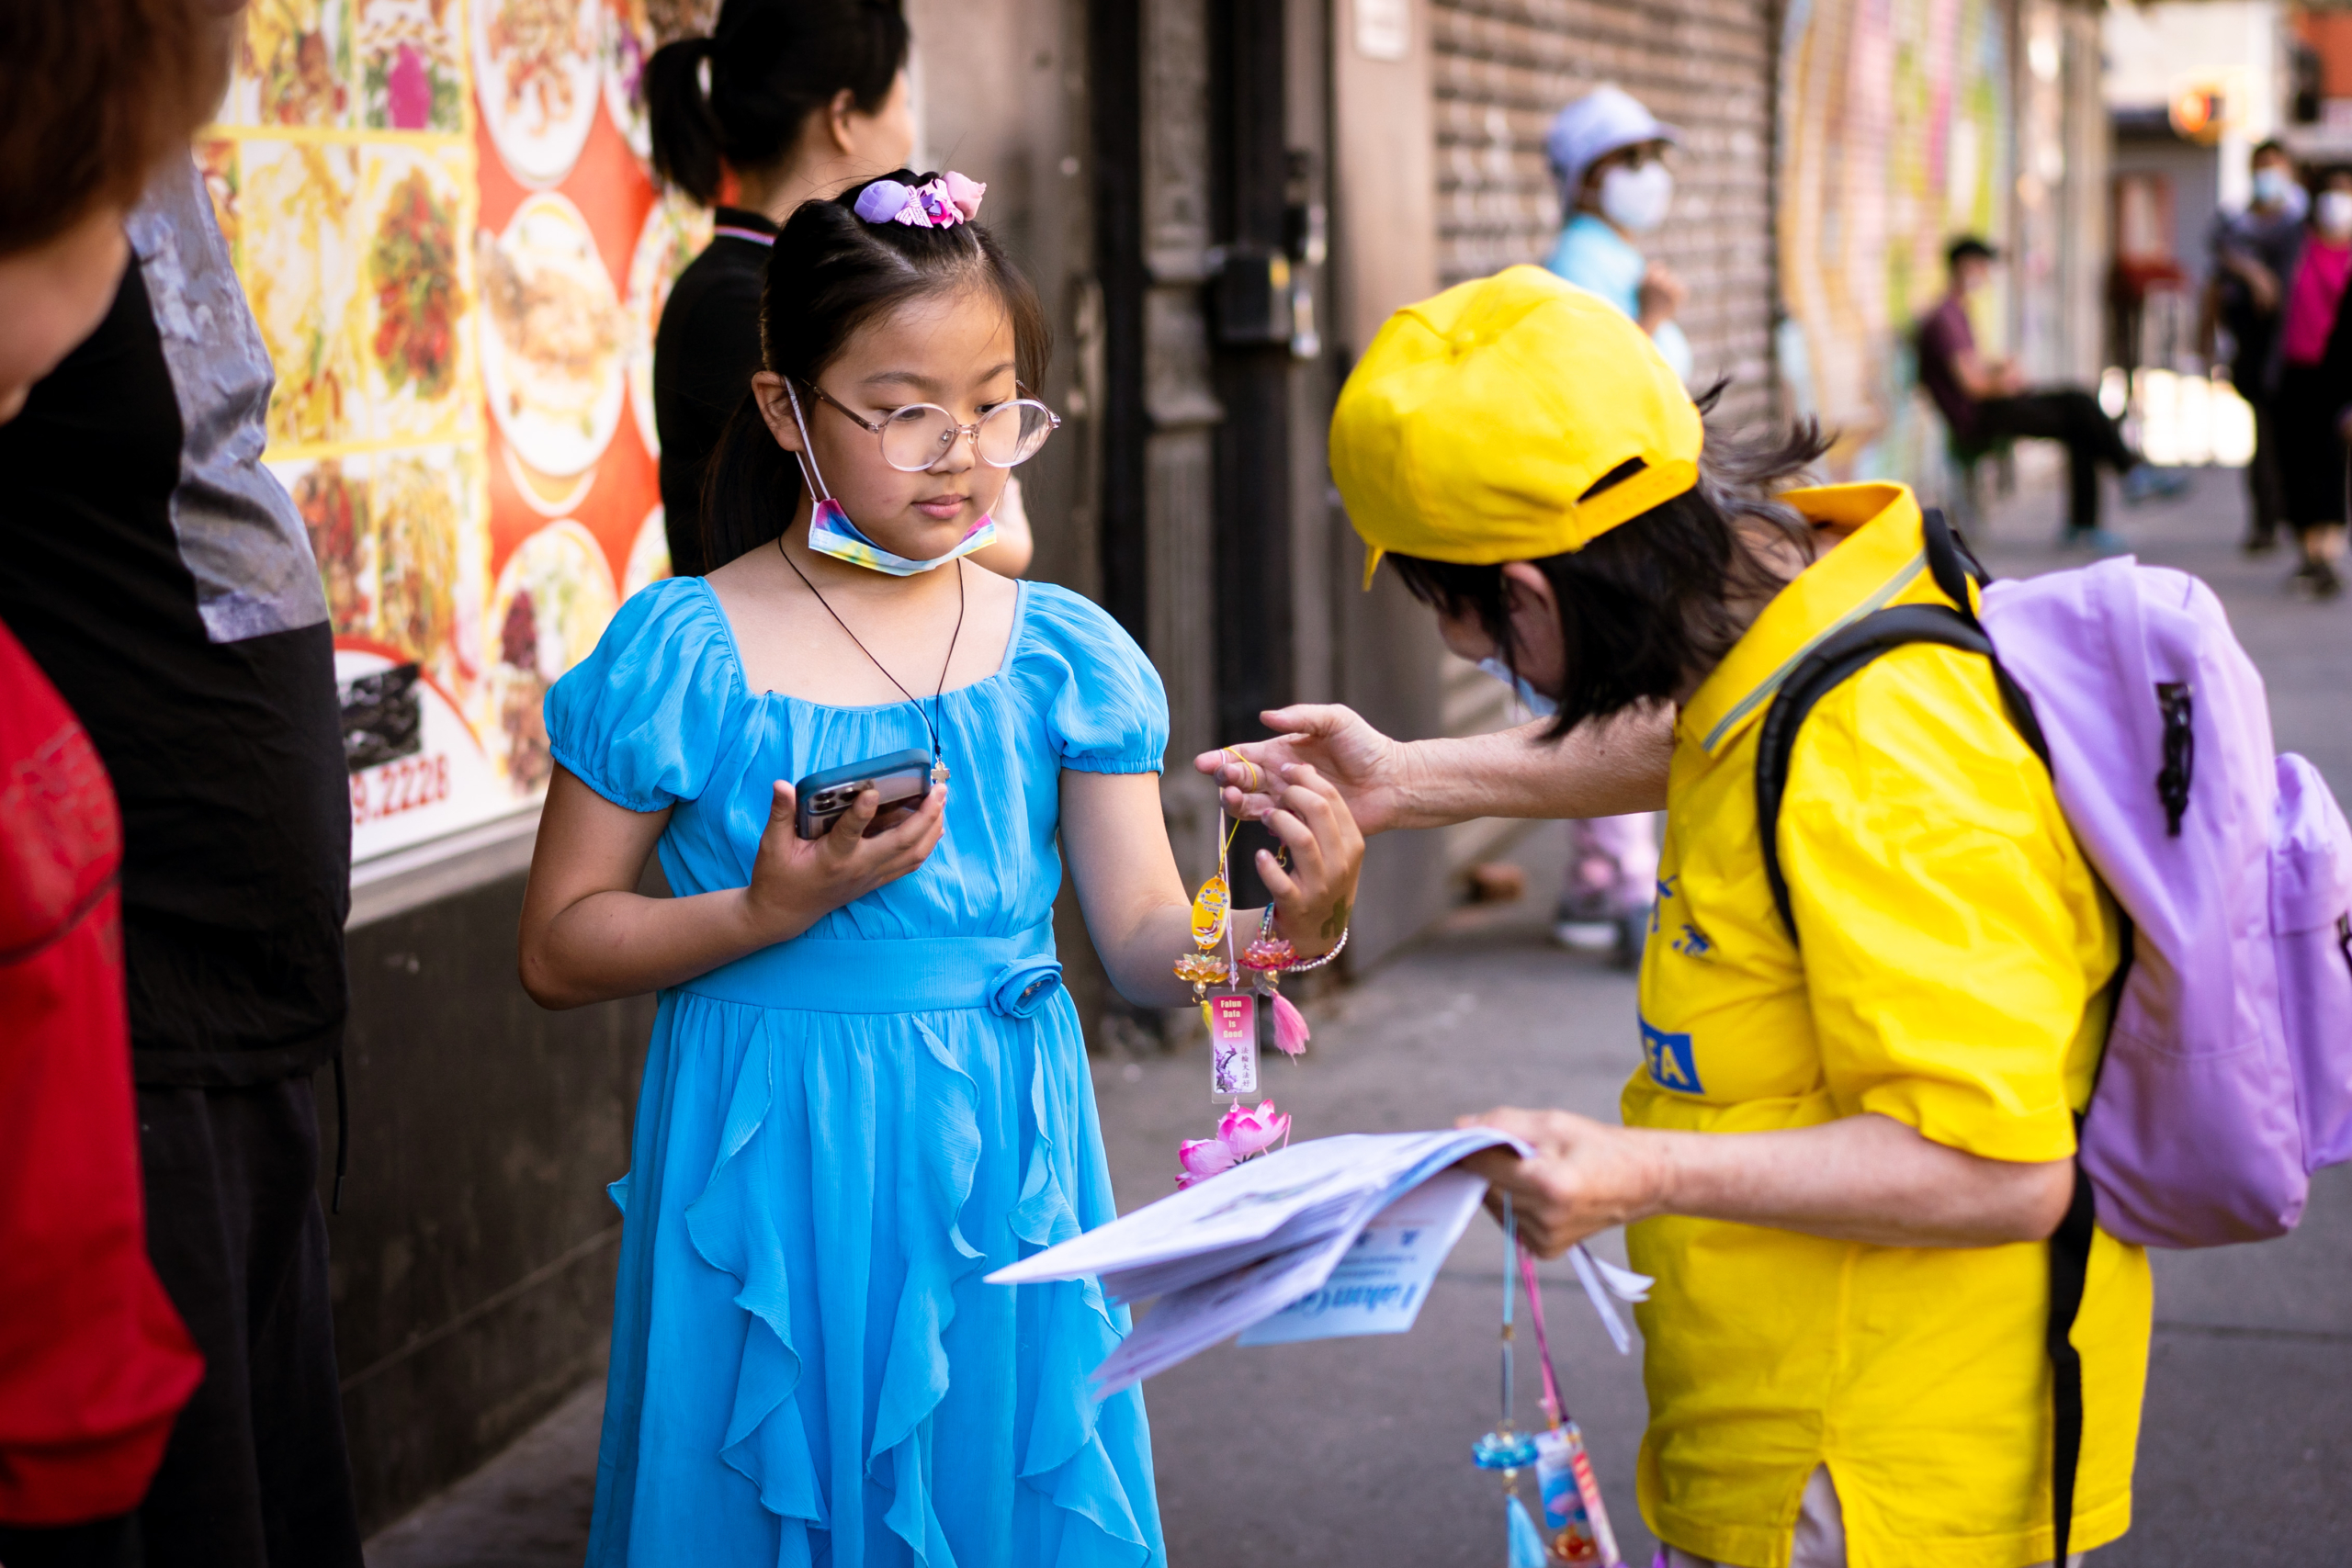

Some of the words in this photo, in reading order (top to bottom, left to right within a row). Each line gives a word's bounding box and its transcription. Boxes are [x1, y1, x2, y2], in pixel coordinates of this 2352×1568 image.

[1220, 999, 1242, 1008] Falun
[1223, 1010, 1241, 1018] Dafa
[1223, 1030, 1243, 1038] Good
[1240, 1045, 1250, 1088] 法輪大法好
